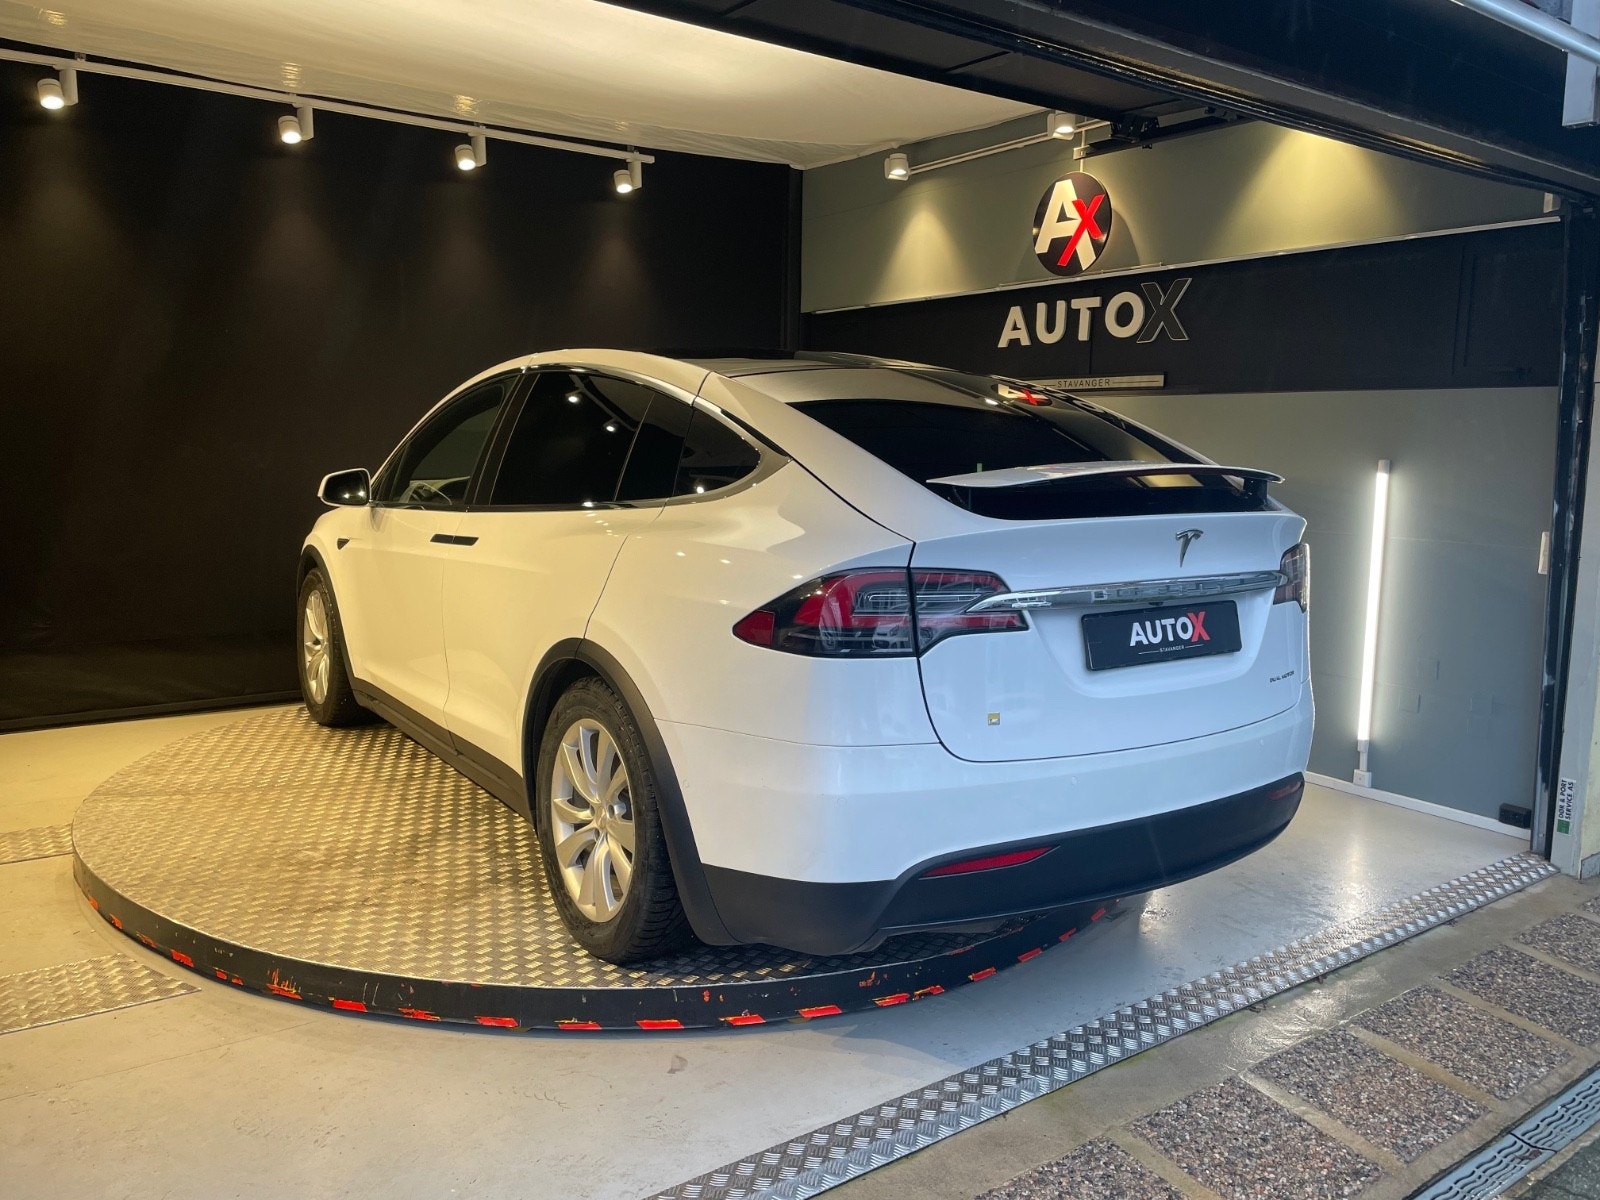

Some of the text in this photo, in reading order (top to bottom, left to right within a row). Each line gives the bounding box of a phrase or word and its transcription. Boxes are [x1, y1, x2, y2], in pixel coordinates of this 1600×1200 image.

[997, 278, 1193, 348] AUTOX
[1057, 378, 1111, 389] STAVANGER
[1129, 611, 1211, 647] AUTOX
[1565, 781, 1574, 820] SERVICE AS
